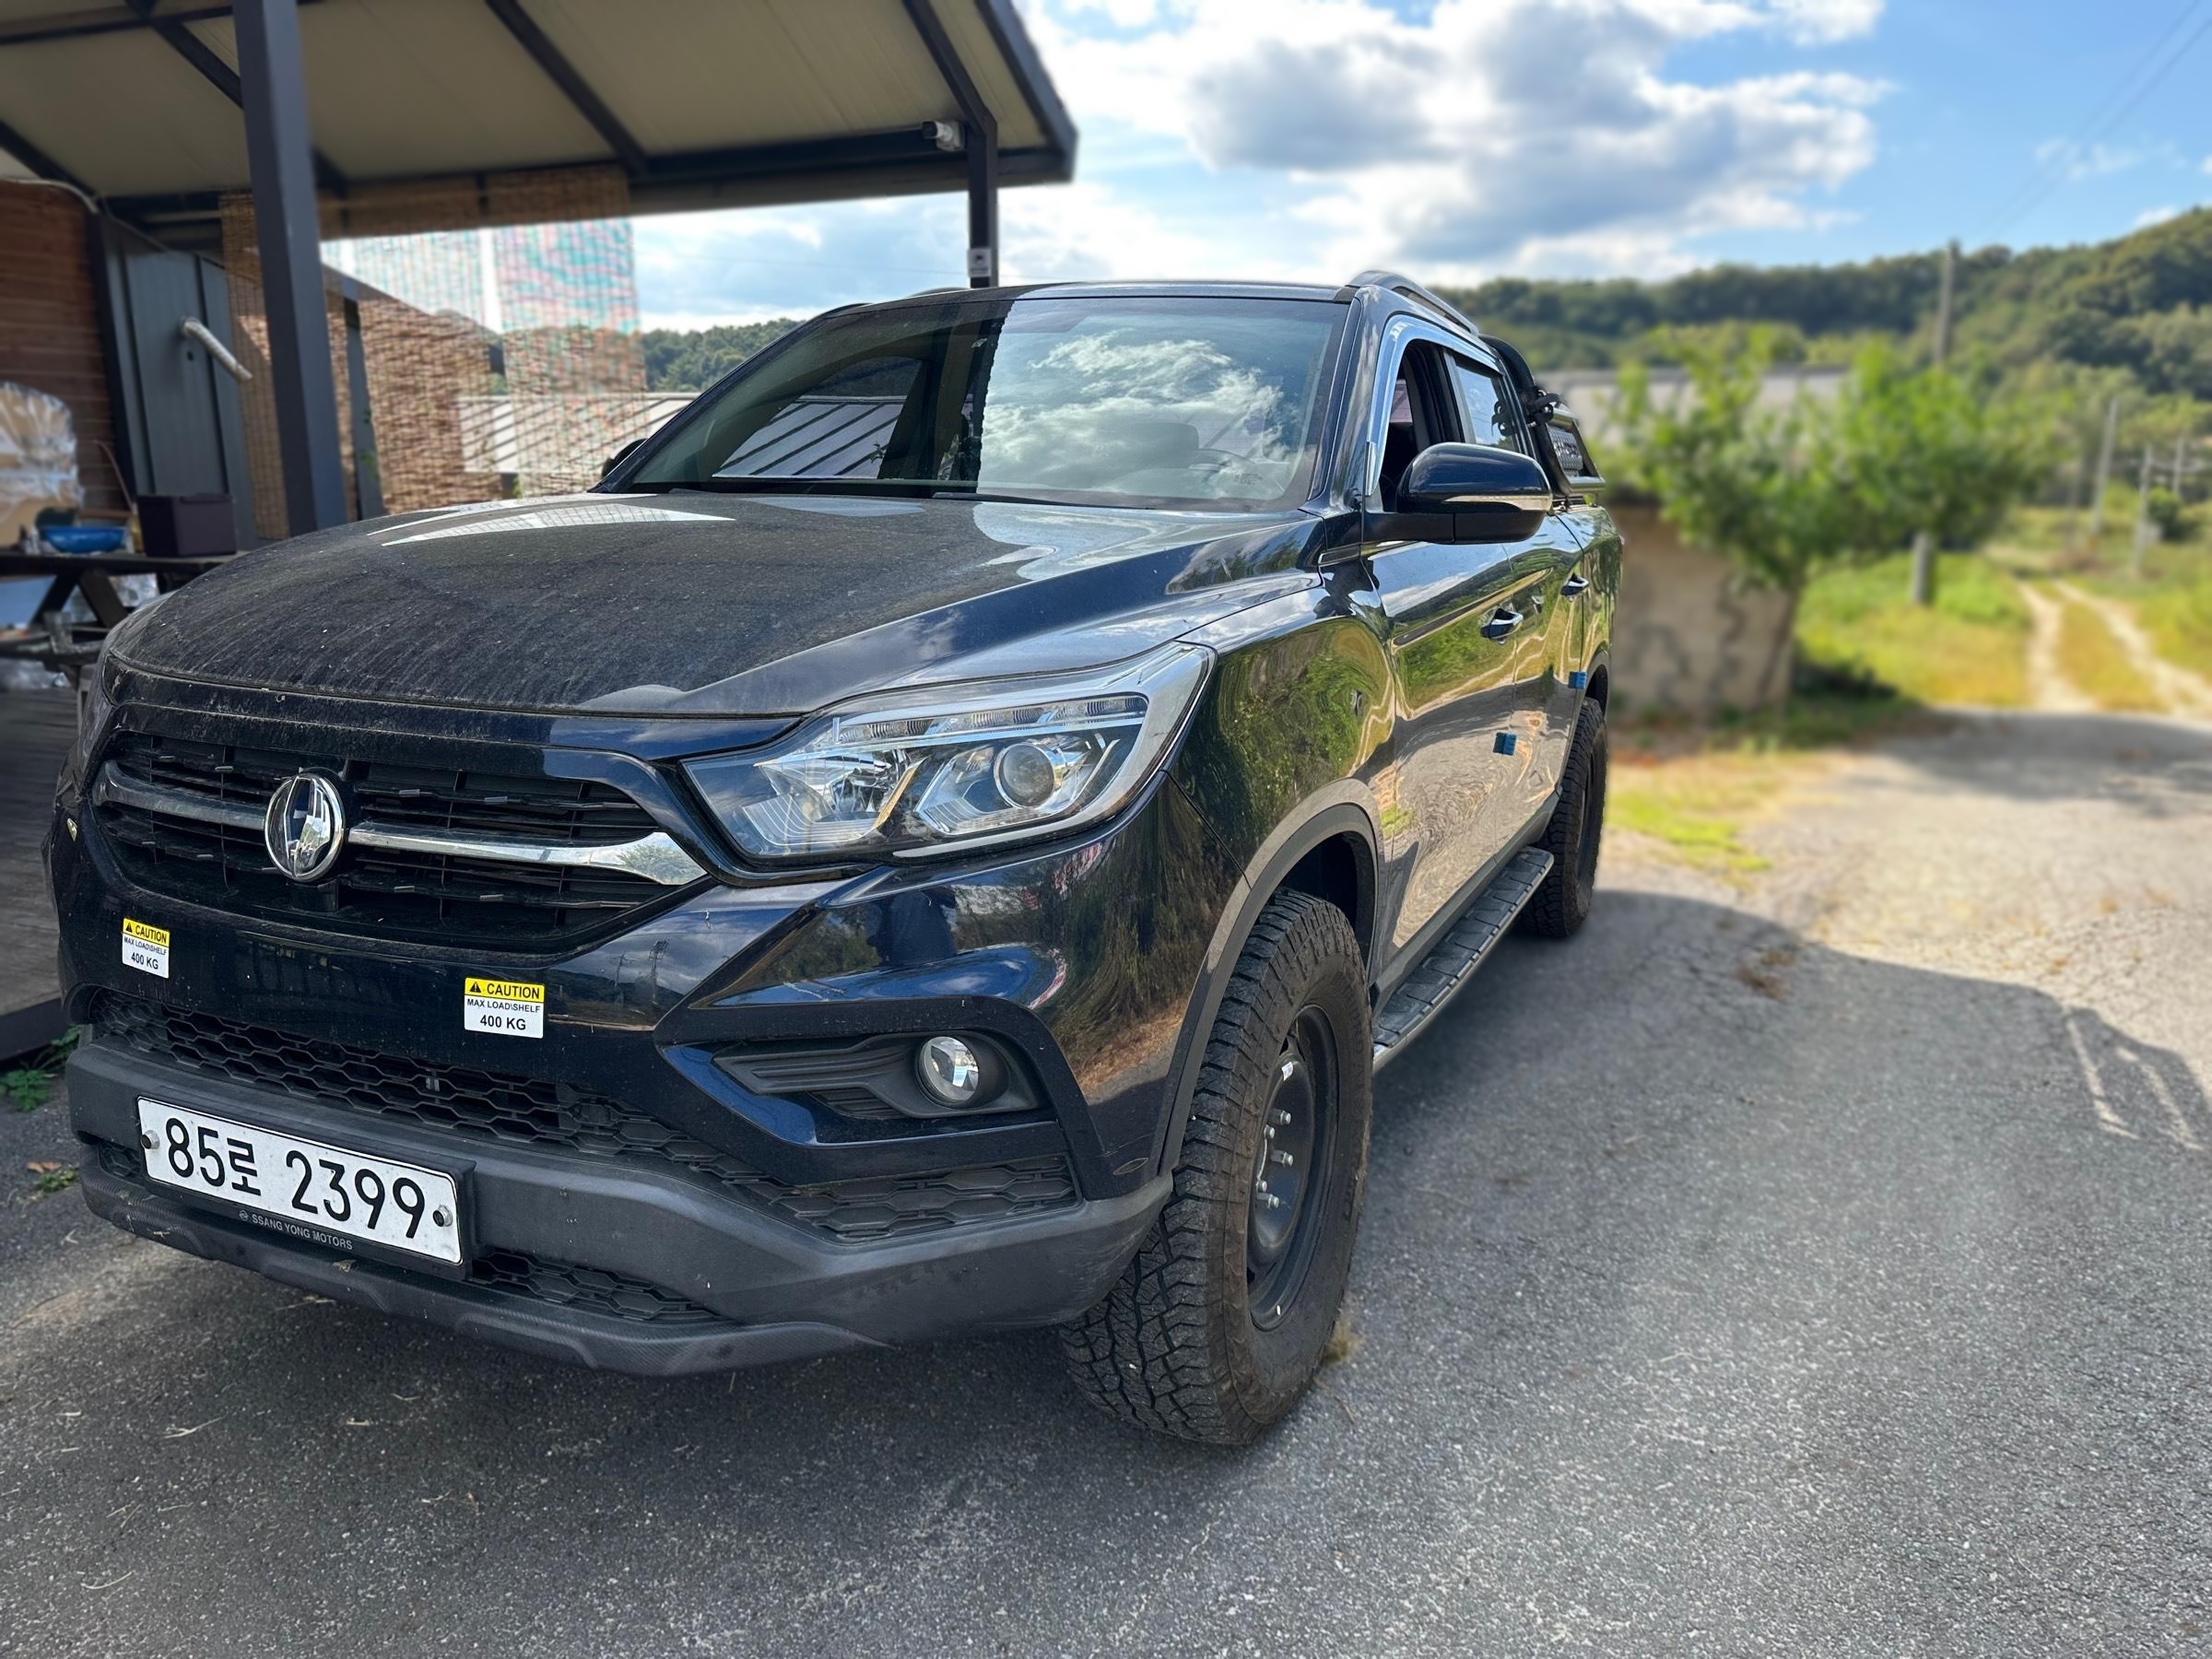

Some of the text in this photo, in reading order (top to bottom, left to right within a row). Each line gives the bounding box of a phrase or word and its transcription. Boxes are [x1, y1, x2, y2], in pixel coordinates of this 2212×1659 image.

[124, 936, 135, 946] MAX
[135, 924, 167, 944] CAUTION
[131, 952, 159, 970] 400 KG
[487, 982, 540, 1000] CAUTION
[466, 998, 486, 1008] MAX
[480, 1015, 526, 1030] 400 KG
[165, 1117, 425, 1239] 85로 2399
[252, 1214, 353, 1250] SSANG YONG MOTORS
